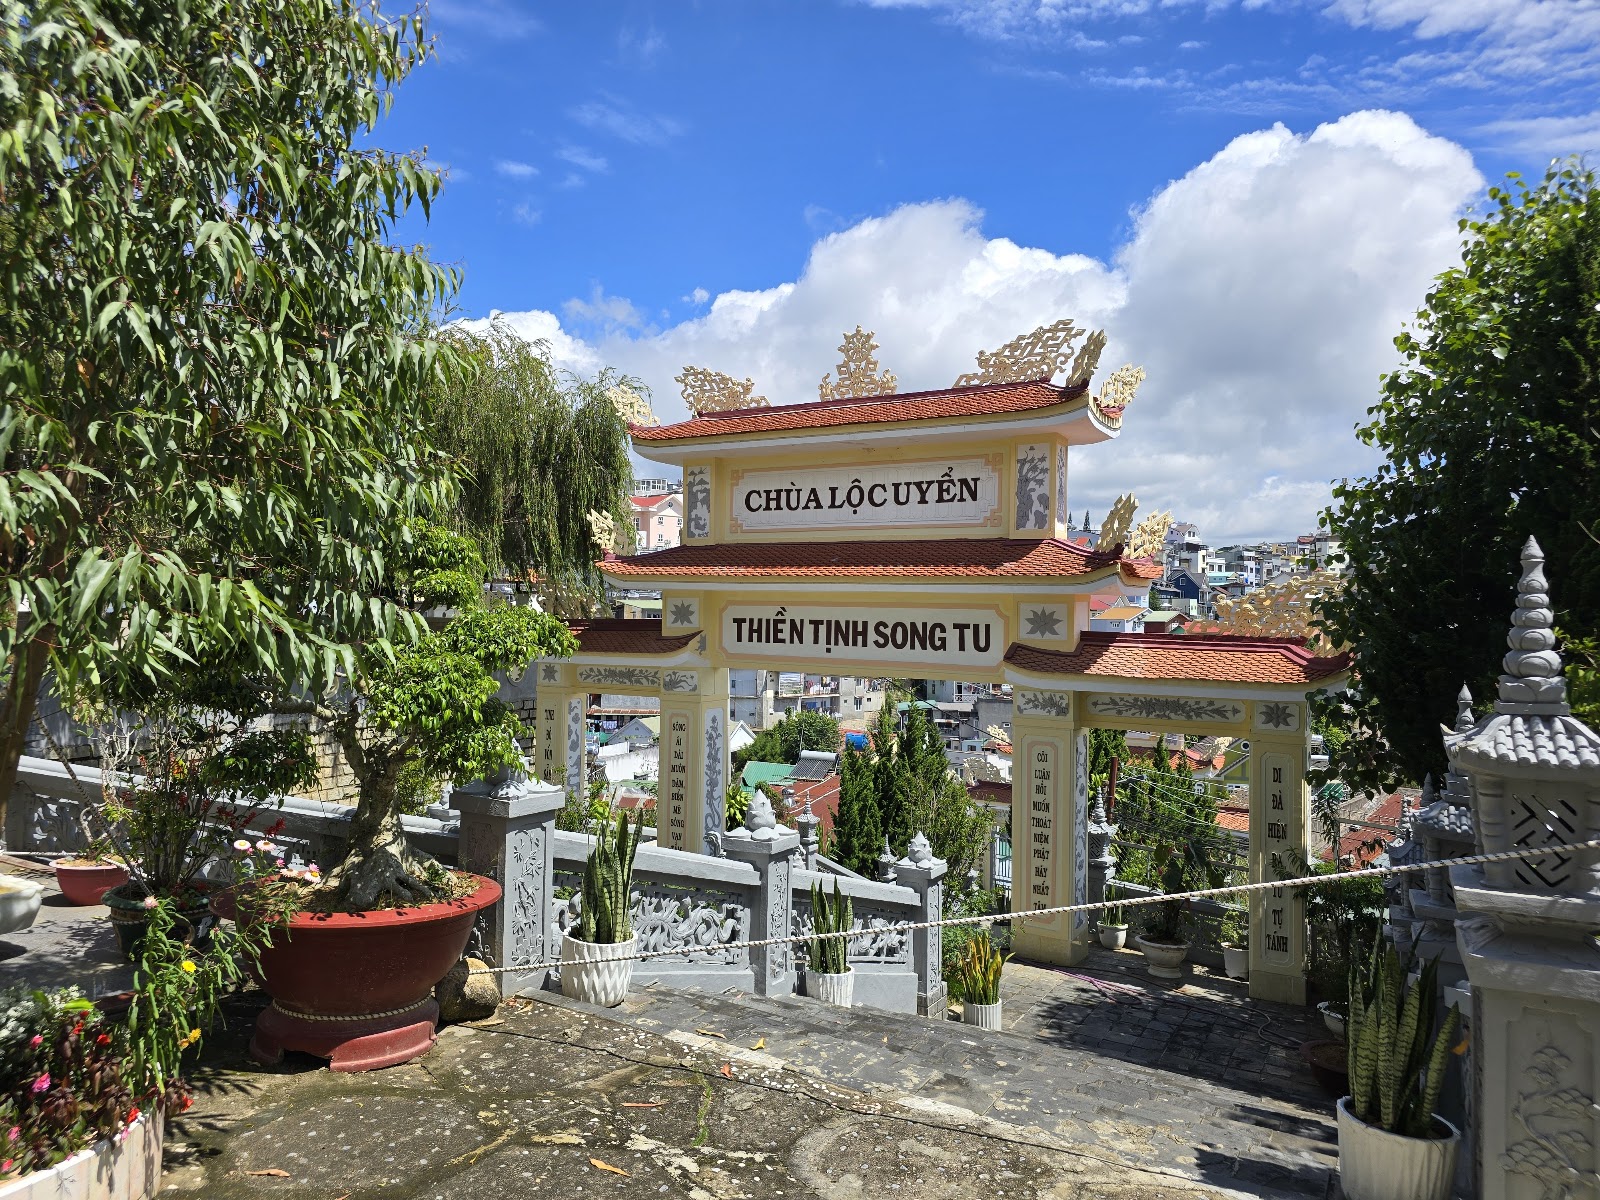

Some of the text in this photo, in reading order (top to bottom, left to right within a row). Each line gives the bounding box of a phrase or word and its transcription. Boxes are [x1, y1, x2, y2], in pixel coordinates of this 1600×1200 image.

[744, 466, 981, 515] CHÙA LỘC UYỂN
[732, 606, 992, 654] THIỀN TỊNH SONG TU
[1272, 767, 1282, 783] DI
[1271, 789, 1284, 810] ĐÀ
[1267, 818, 1288, 843] HIỆN
[1271, 908, 1283, 929] TỰ
[1265, 930, 1289, 953] TÁNH
